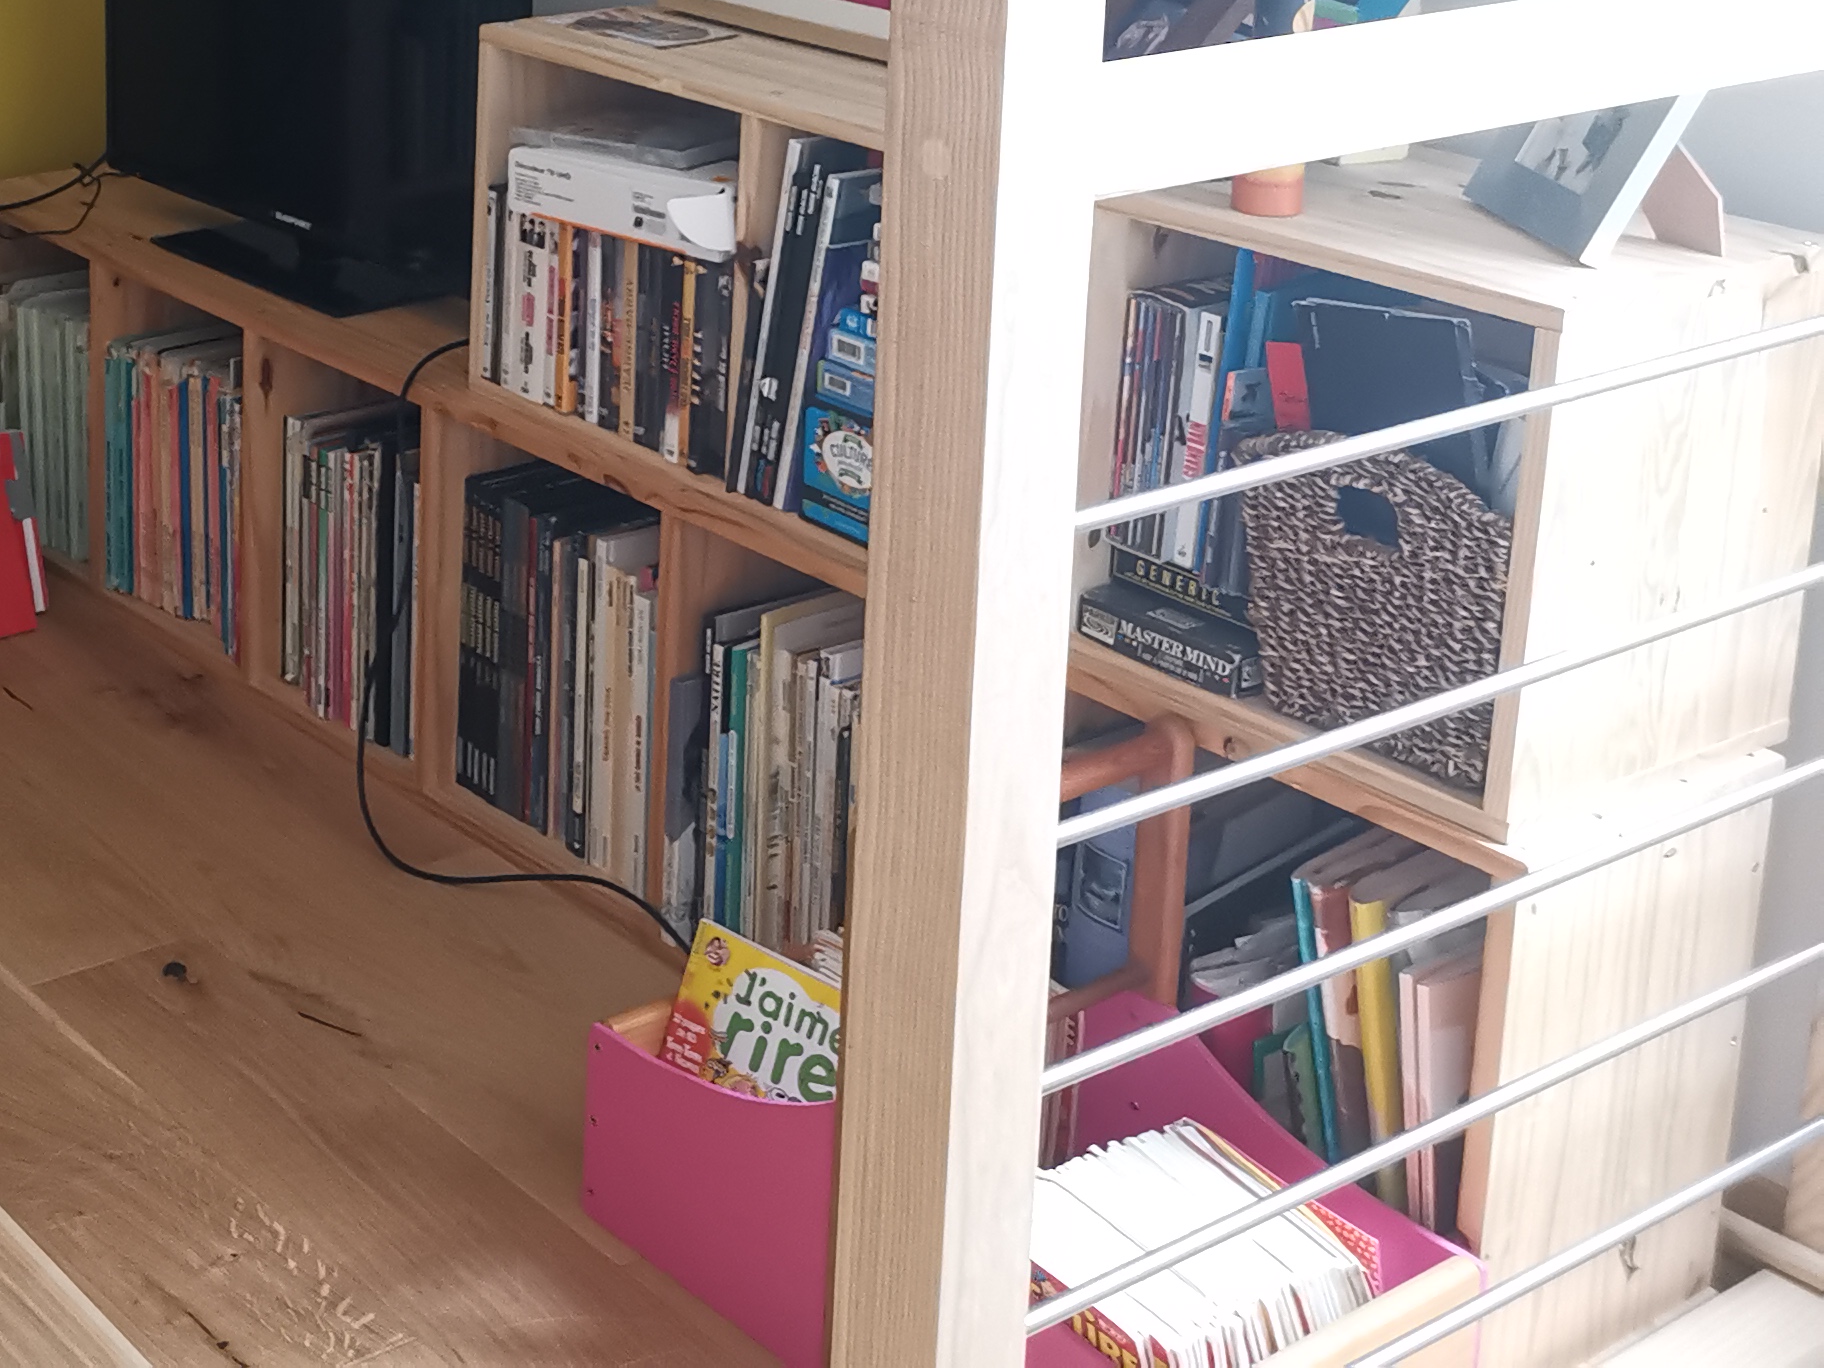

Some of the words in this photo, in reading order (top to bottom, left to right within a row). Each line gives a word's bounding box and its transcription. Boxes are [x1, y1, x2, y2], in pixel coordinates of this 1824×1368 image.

[1135, 559, 1222, 607] GENERIC
[735, 969, 842, 1055] J'aime
[719, 1011, 837, 1103] rire
